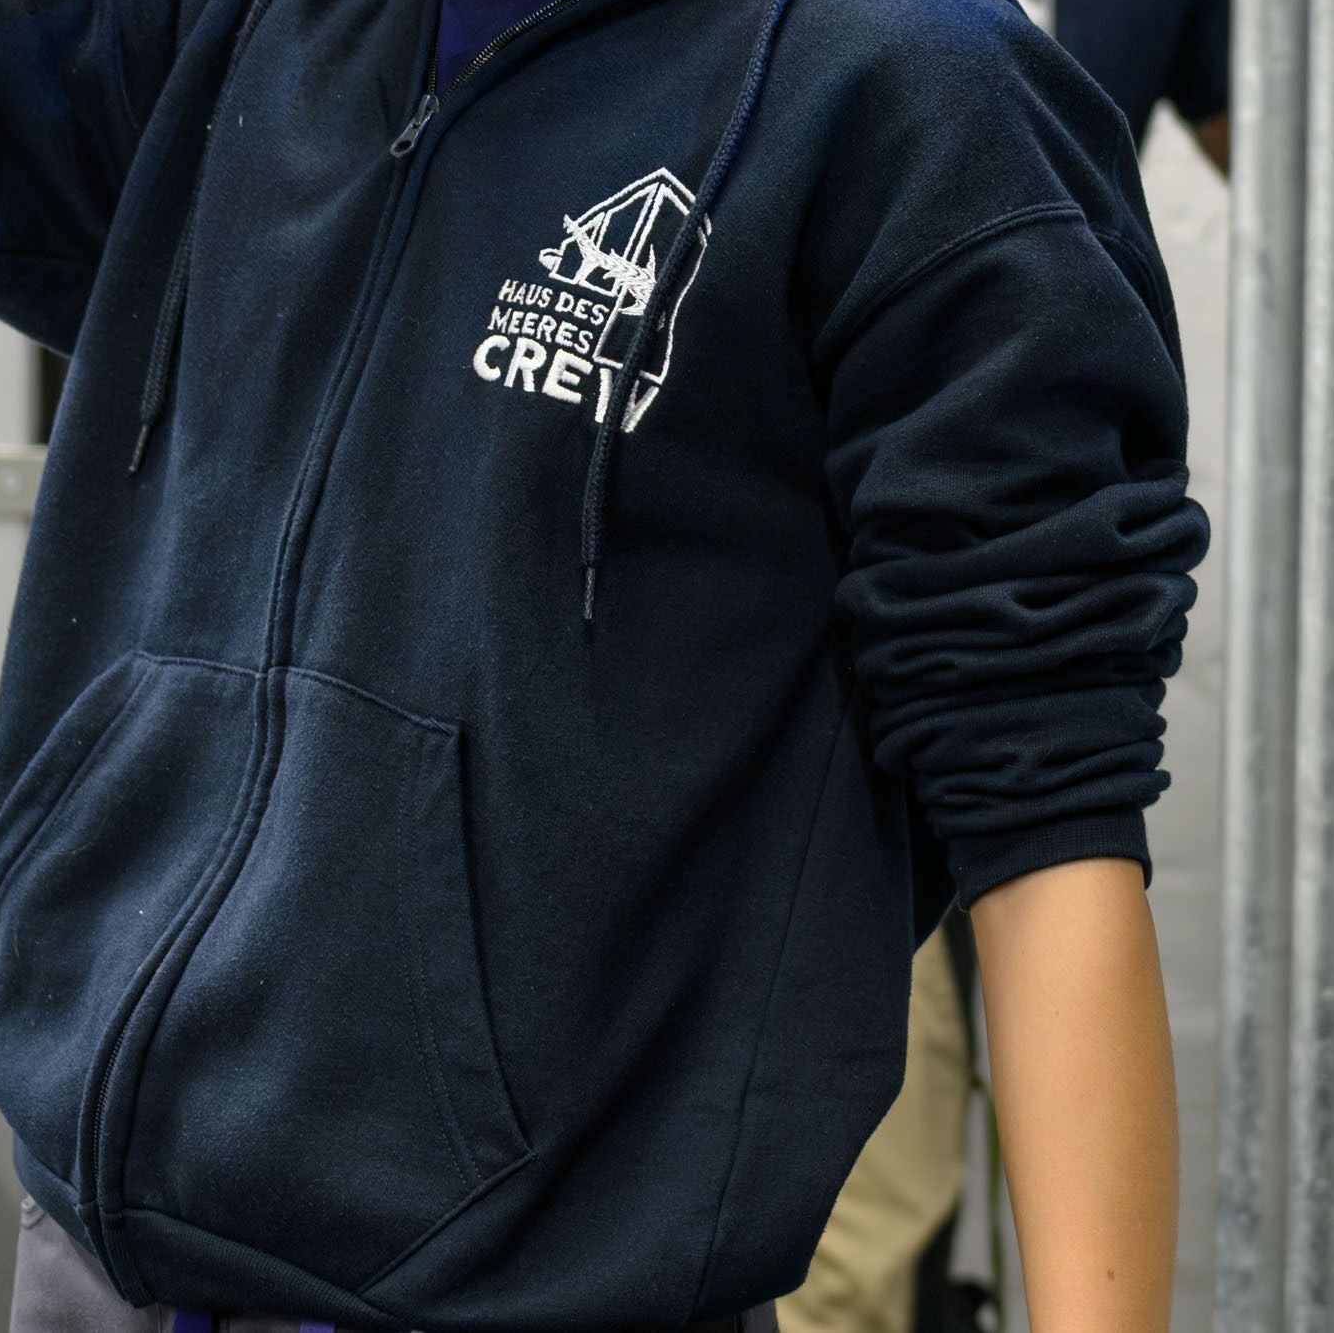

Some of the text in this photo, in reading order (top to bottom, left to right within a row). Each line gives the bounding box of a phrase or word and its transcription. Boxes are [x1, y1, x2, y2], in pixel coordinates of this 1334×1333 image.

[497, 278, 610, 326] HAUS DES
[487, 306, 594, 354] MEERES
